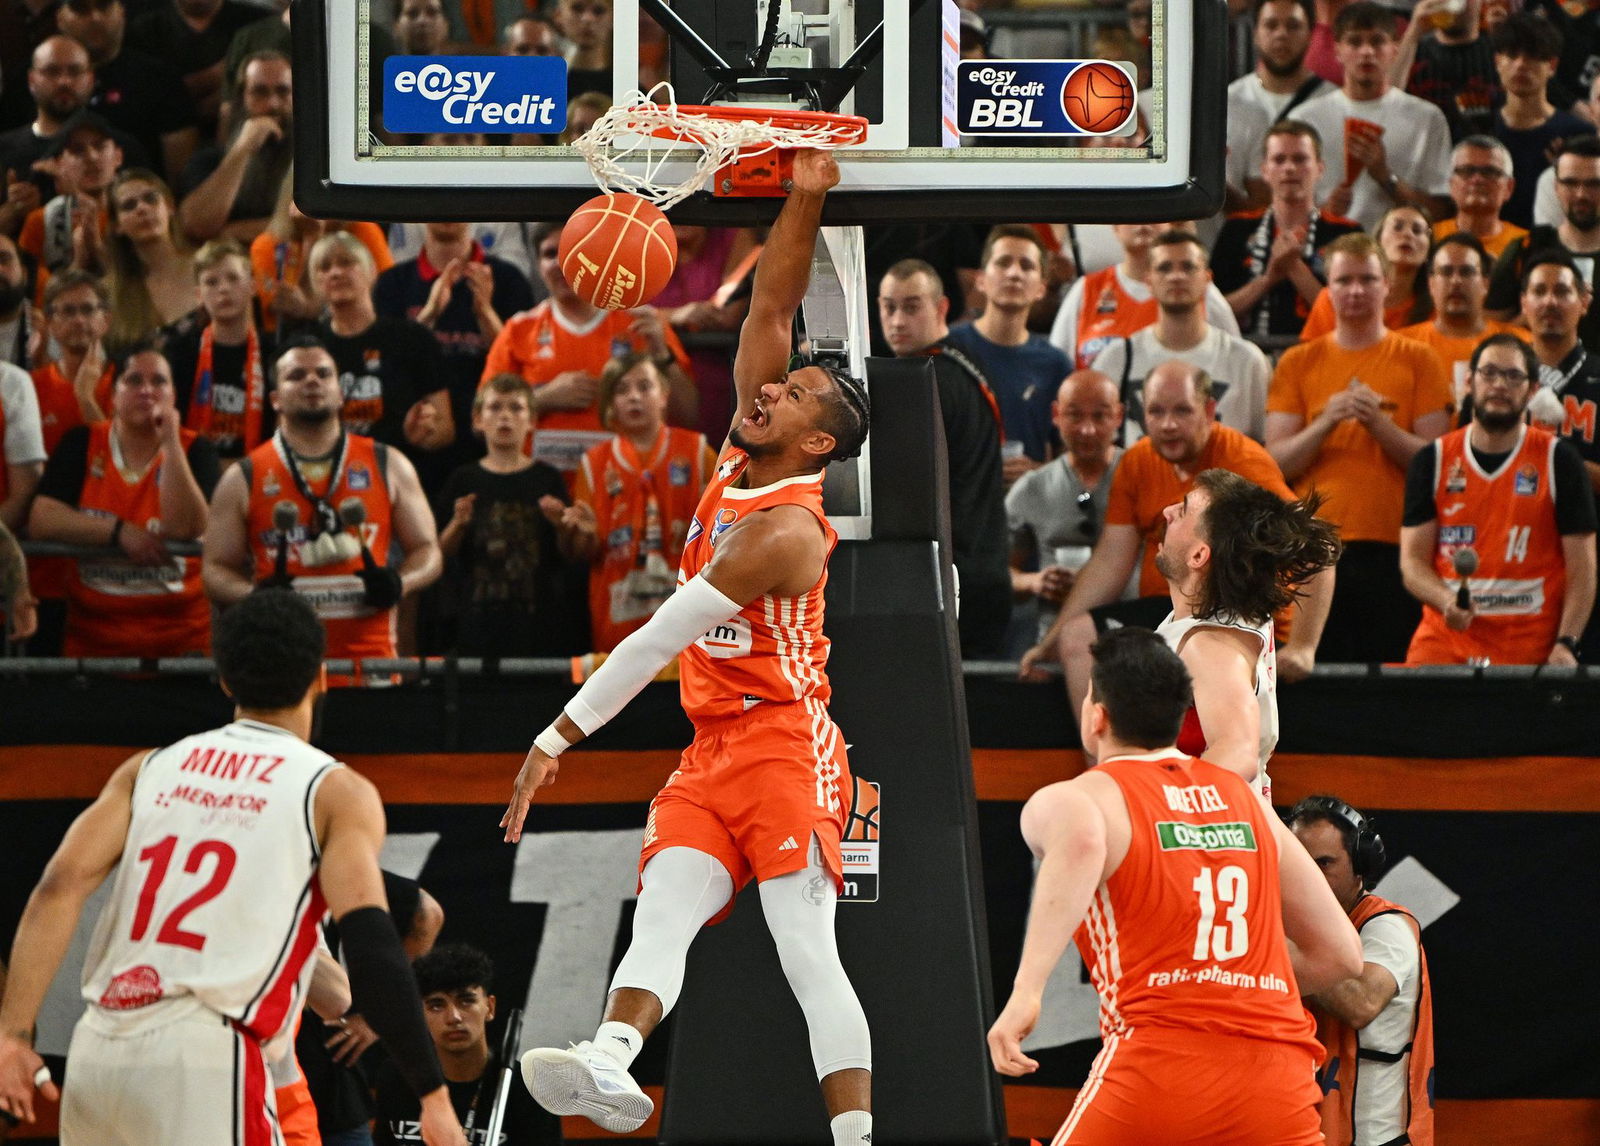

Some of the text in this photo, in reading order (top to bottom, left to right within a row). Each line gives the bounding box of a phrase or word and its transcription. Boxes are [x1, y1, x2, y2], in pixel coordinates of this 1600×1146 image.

[394, 63, 496, 102] e@sy
[968, 67, 1017, 86] e@sy
[991, 81, 1045, 97] Credit
[442, 94, 556, 125] Credit
[968, 99, 1044, 128] BBL
[1504, 525, 1531, 564] 14
[180, 747, 286, 784] MINTZ
[129, 834, 238, 954] 12
[1192, 865, 1249, 962] 13
[1259, 973, 1290, 995] ulm
